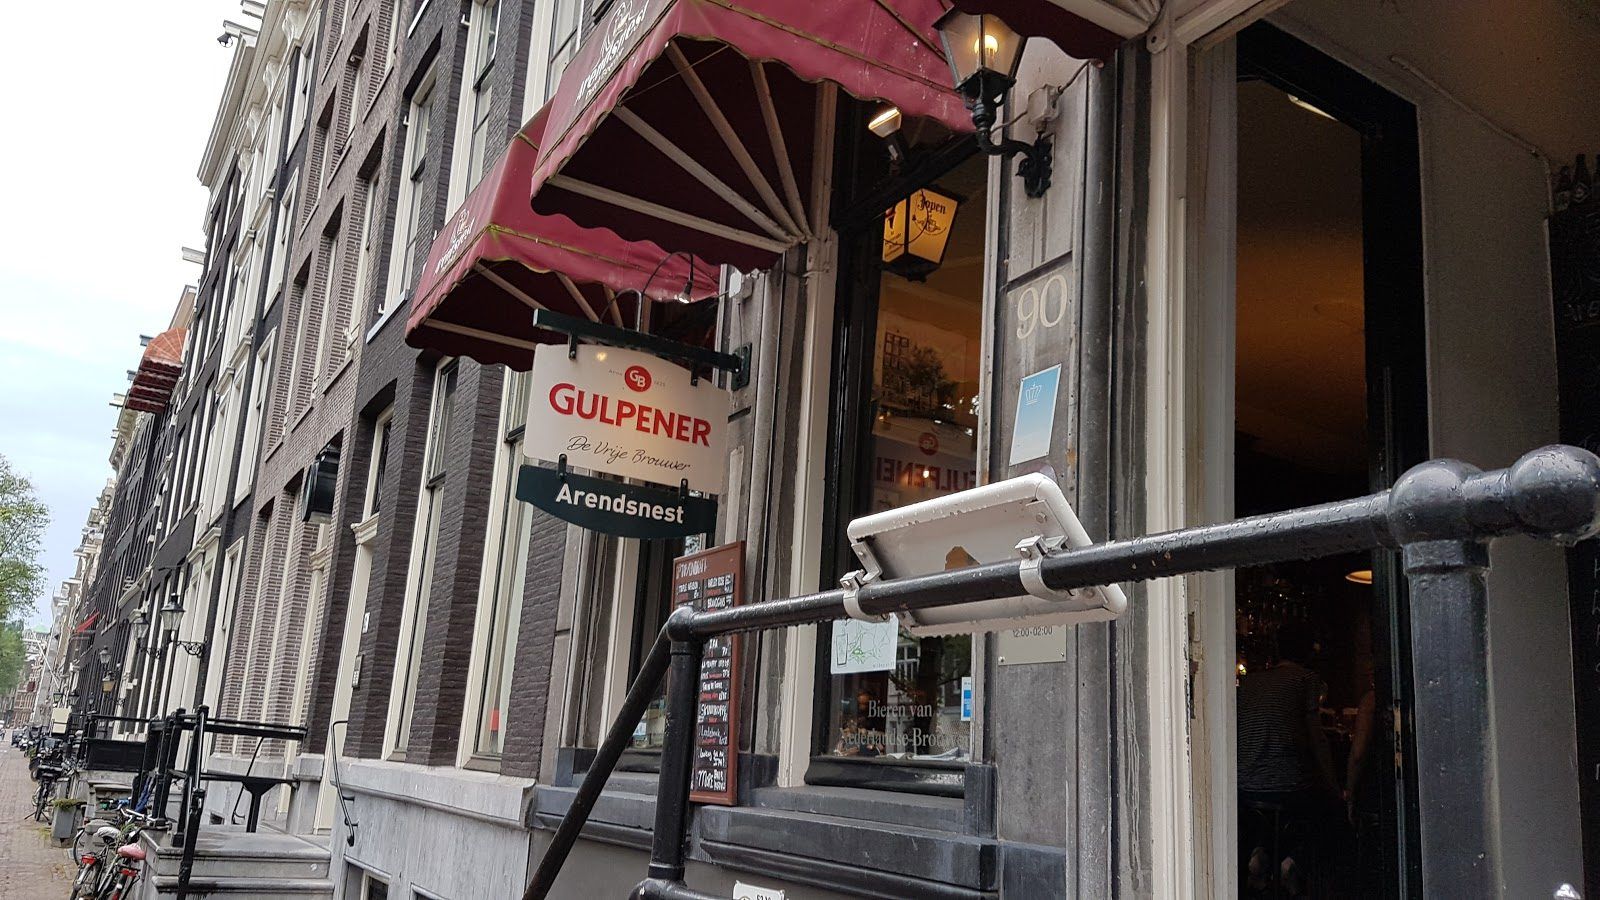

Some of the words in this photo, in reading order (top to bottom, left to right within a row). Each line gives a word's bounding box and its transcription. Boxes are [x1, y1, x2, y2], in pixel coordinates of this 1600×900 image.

[1016, 274, 1068, 340] 90
[629, 369, 646, 388] GB
[549, 382, 712, 447] GULPENER
[566, 435, 592, 452] De
[594, 441, 629, 465] Vrije
[632, 448, 692, 472] Brouwer
[555, 482, 685, 525] Arendsnest
[867, 698, 906, 719] Bieren
[909, 703, 933, 719] van
